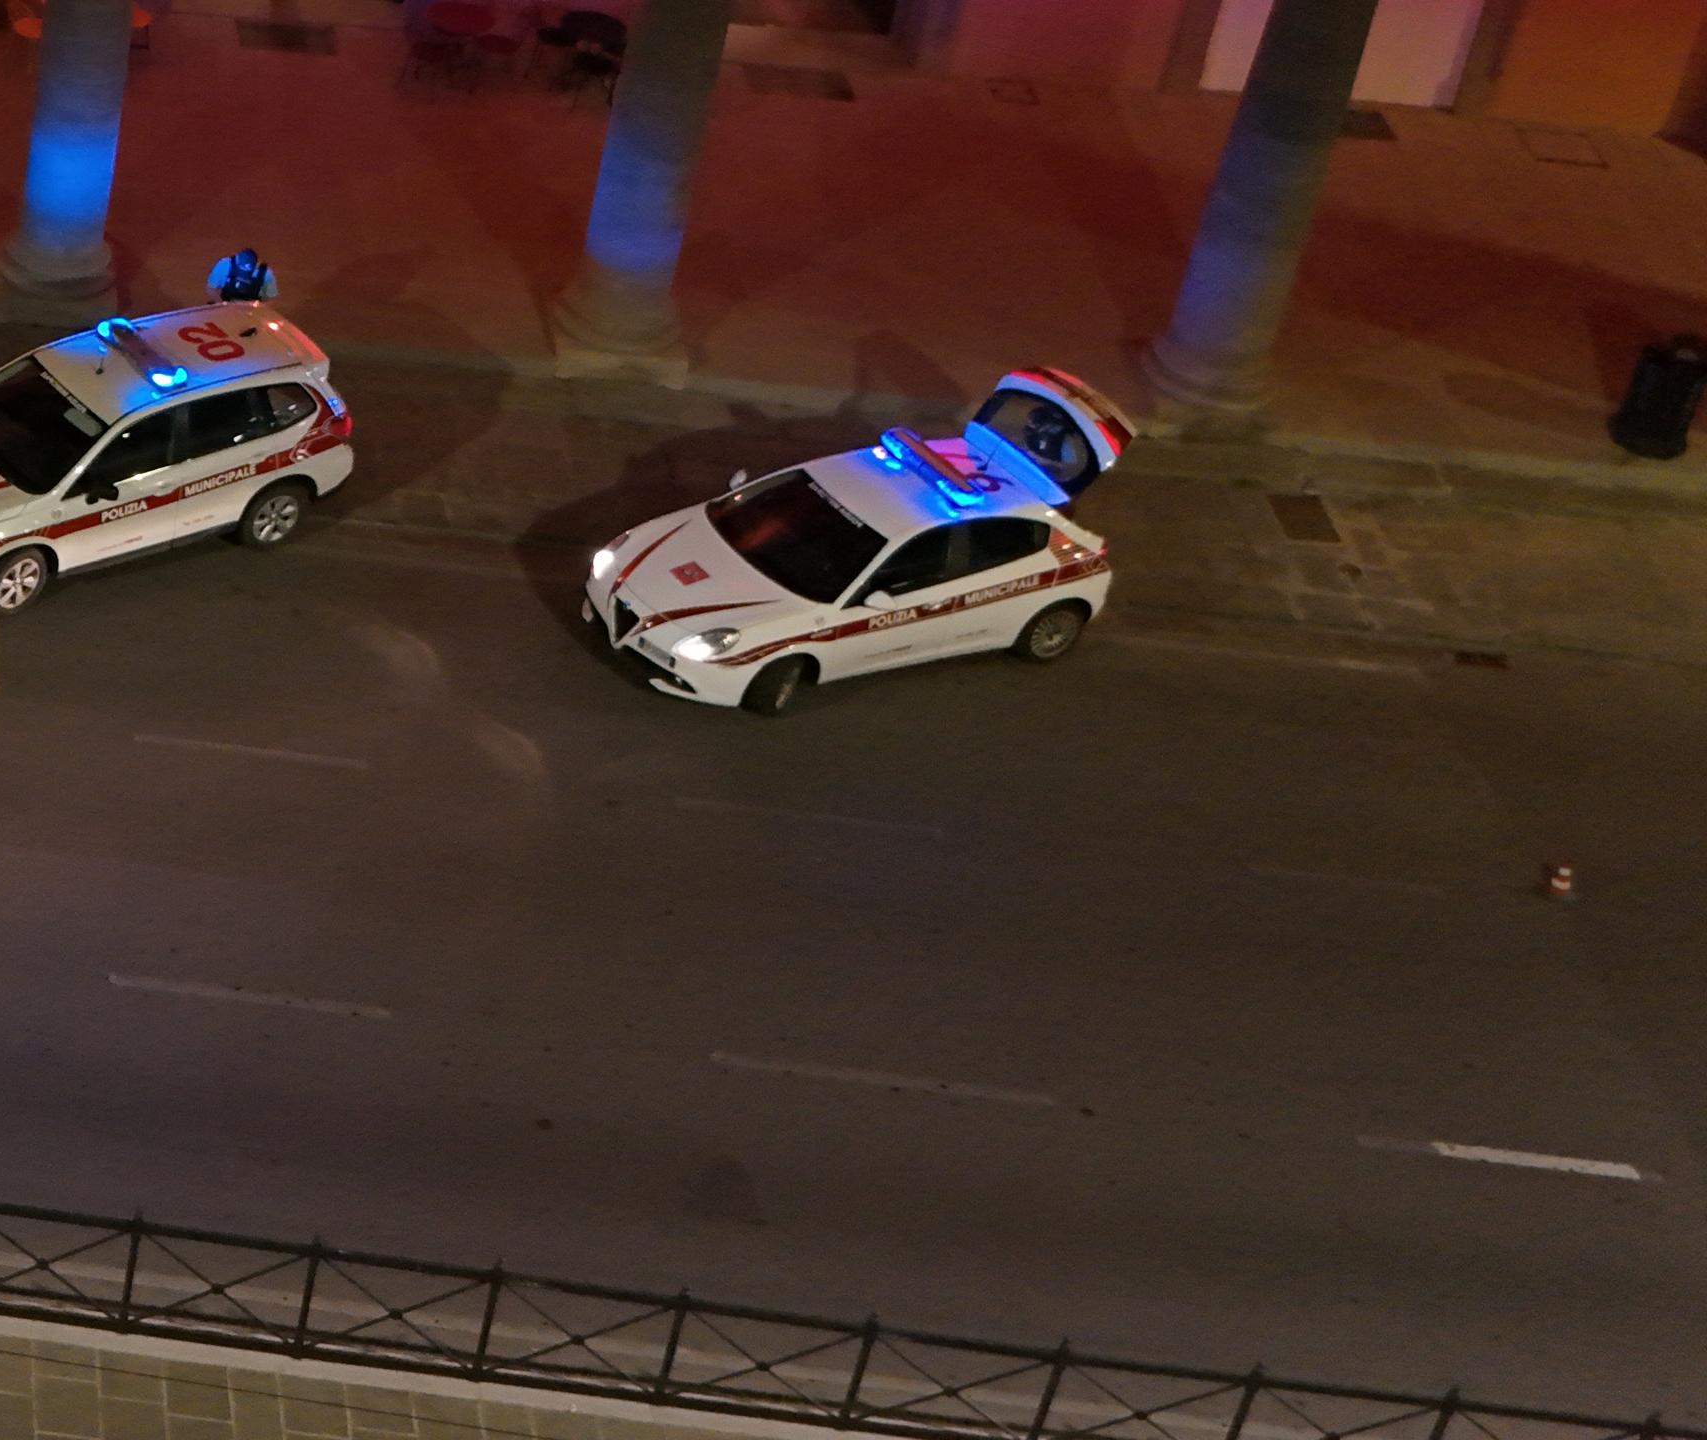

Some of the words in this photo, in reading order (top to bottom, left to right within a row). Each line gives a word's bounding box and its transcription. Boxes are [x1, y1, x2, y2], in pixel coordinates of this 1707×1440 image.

[101, 500, 148, 523] POLIZIA
[184, 464, 256, 498] MUNICIPALE
[868, 609, 918, 630] POLIZIA
[964, 574, 1040, 606] MUNICIPALE
